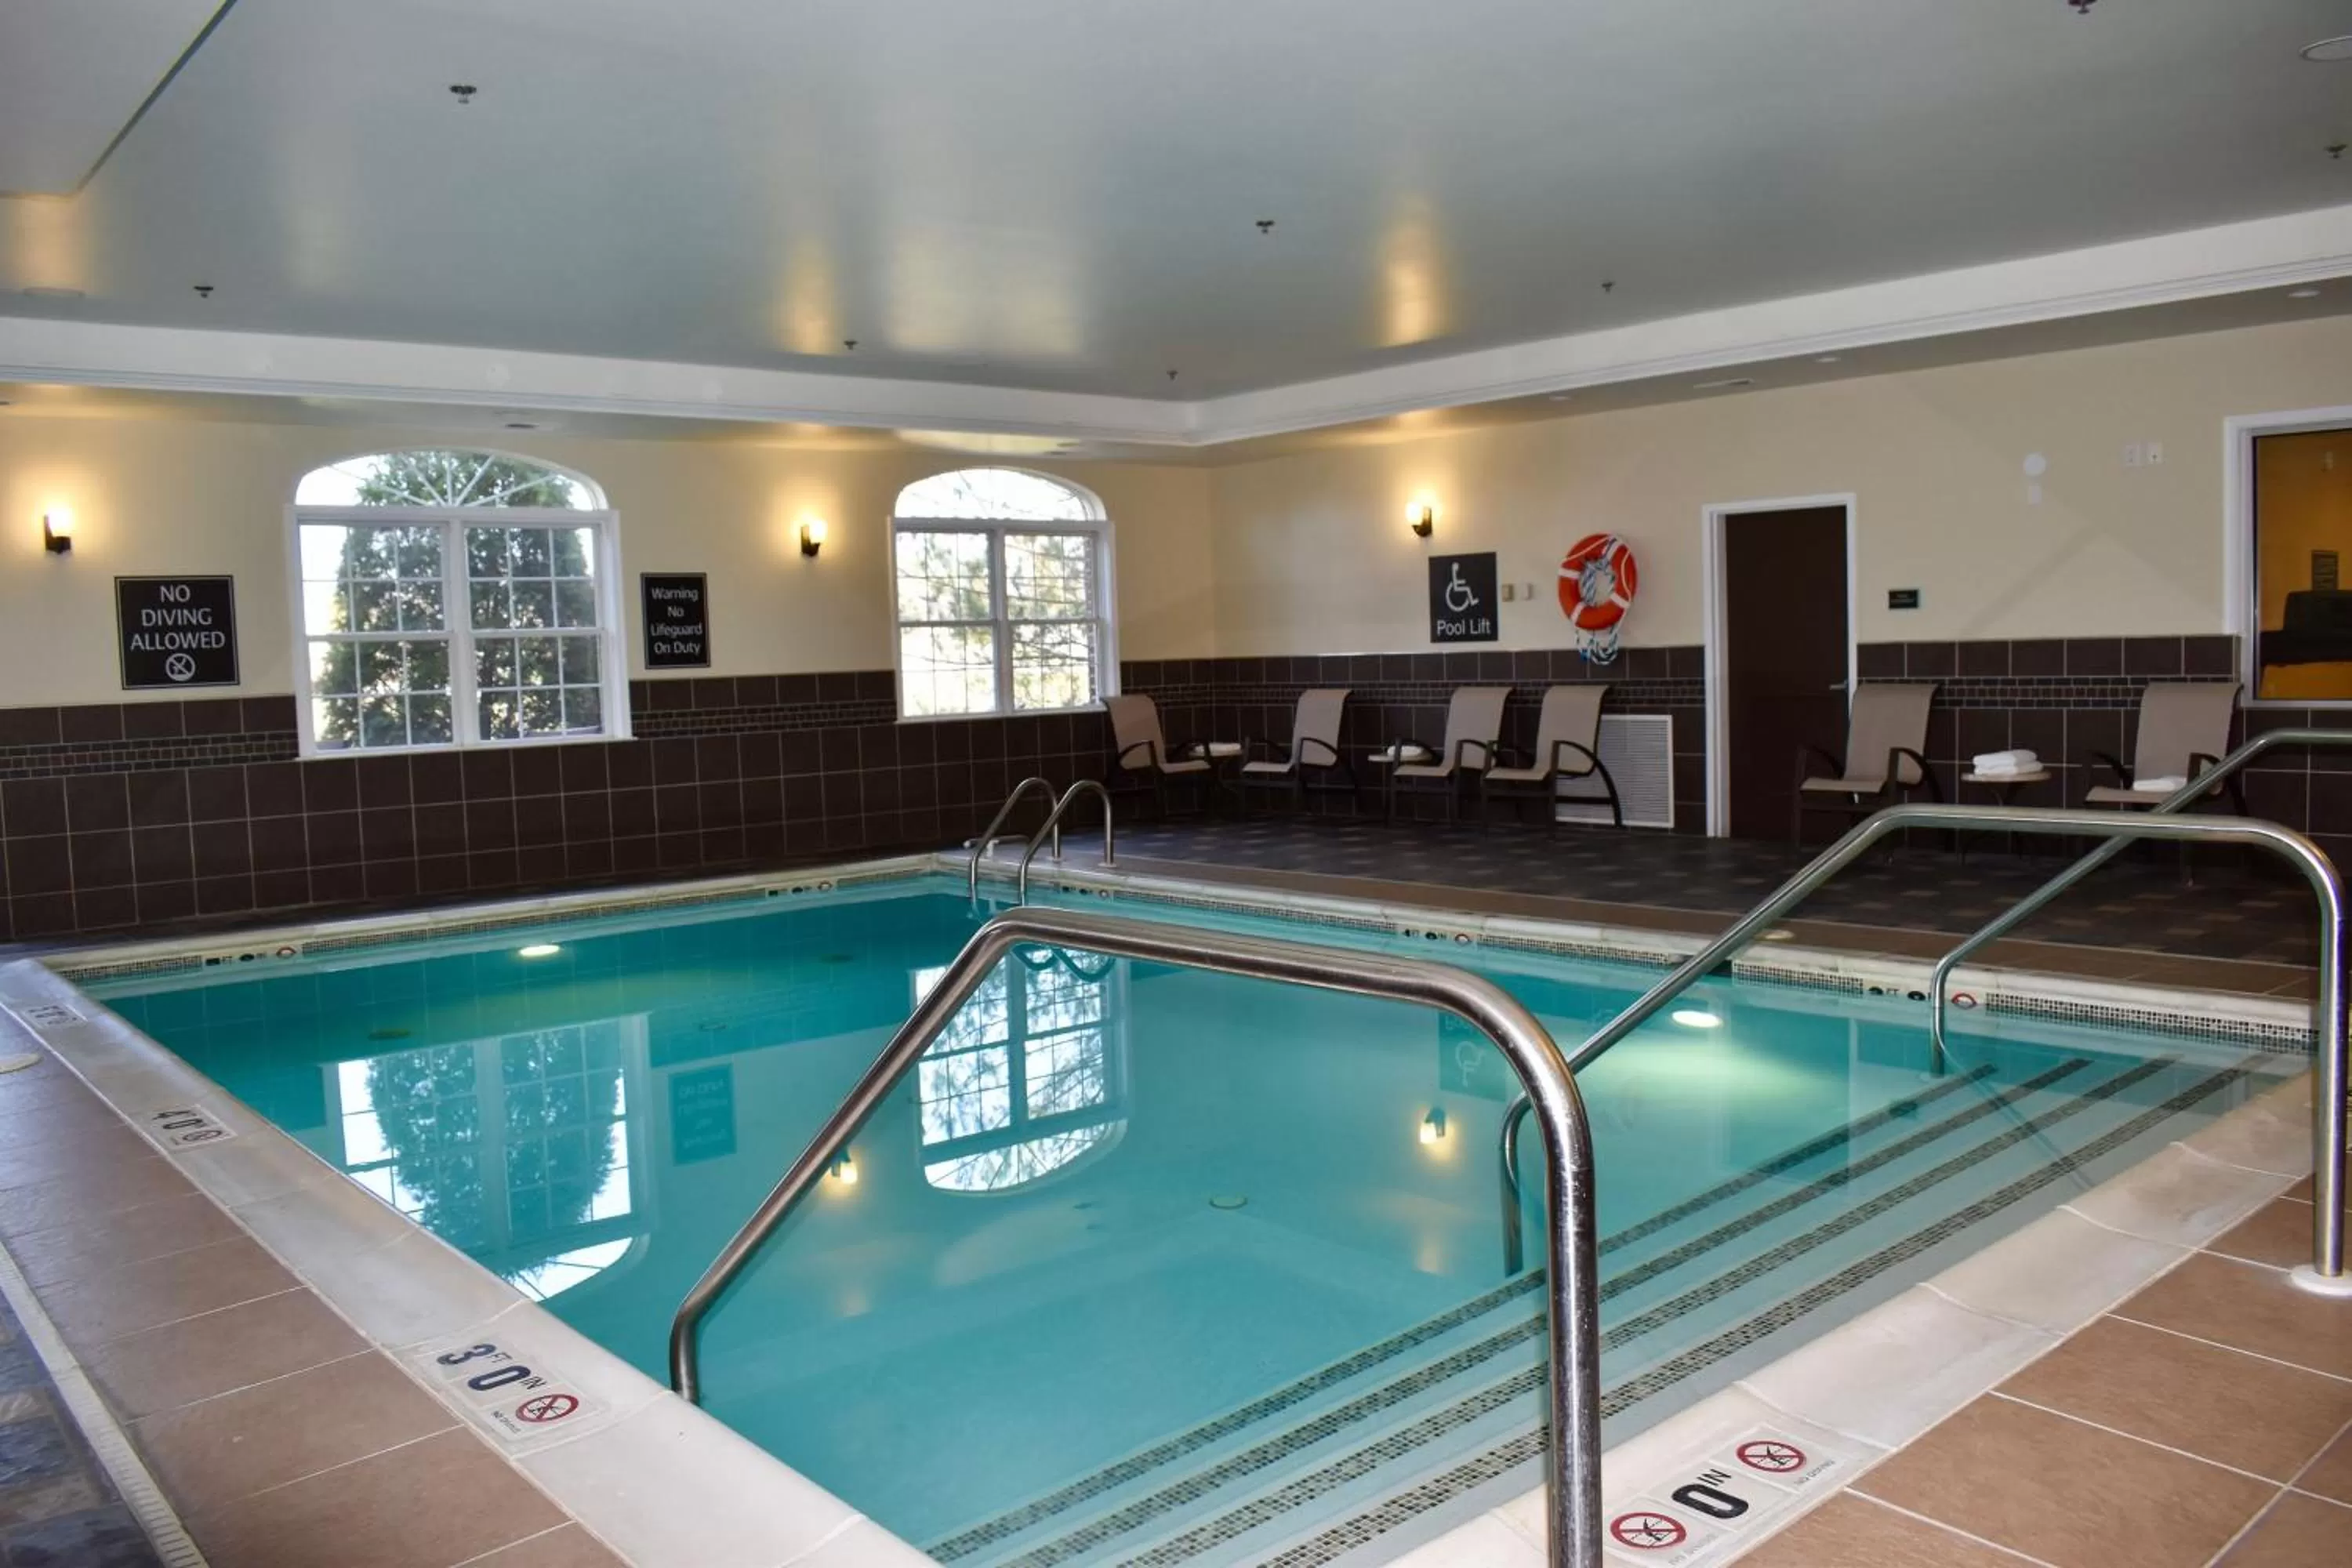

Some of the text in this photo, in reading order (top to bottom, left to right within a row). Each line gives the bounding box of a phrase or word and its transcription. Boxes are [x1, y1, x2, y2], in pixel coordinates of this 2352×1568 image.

[159, 585, 191, 602] NO
[652, 586, 699, 601] Warning
[141, 608, 212, 626] DIVING
[667, 604, 684, 617] No
[650, 622, 702, 637] Lifeguard
[1436, 617, 1491, 636] Pool Lift
[131, 631, 226, 651] ALLOWED
[654, 641, 701, 655] On Duty
[437, 1343, 496, 1365] 3
[467, 1365, 531, 1391] 0
[1696, 1468, 1732, 1486] IN
[1671, 1483, 1749, 1519] 0
